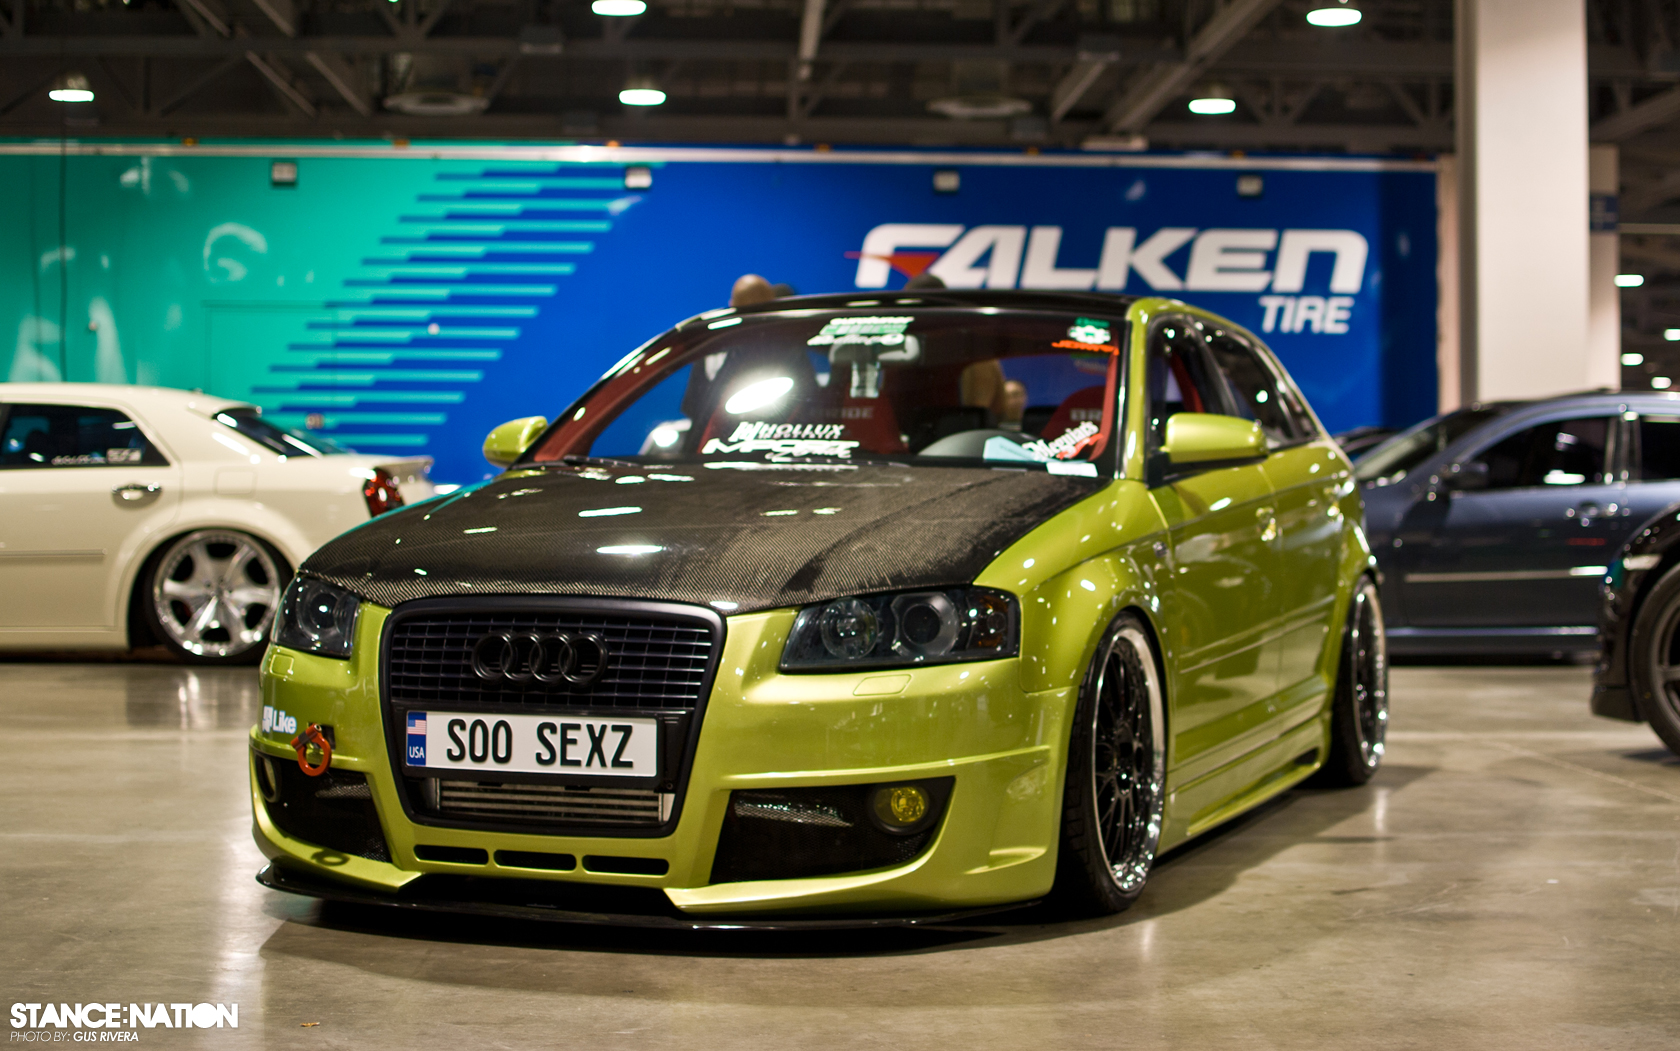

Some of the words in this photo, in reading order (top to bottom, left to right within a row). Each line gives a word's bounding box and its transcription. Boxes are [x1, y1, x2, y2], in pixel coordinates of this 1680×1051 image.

[854, 223, 1369, 293] FALKEN
[1259, 297, 1354, 334] TIRE
[273, 709, 297, 735] Like
[408, 745, 426, 760] USA
[535, 722, 634, 769] SEXZ
